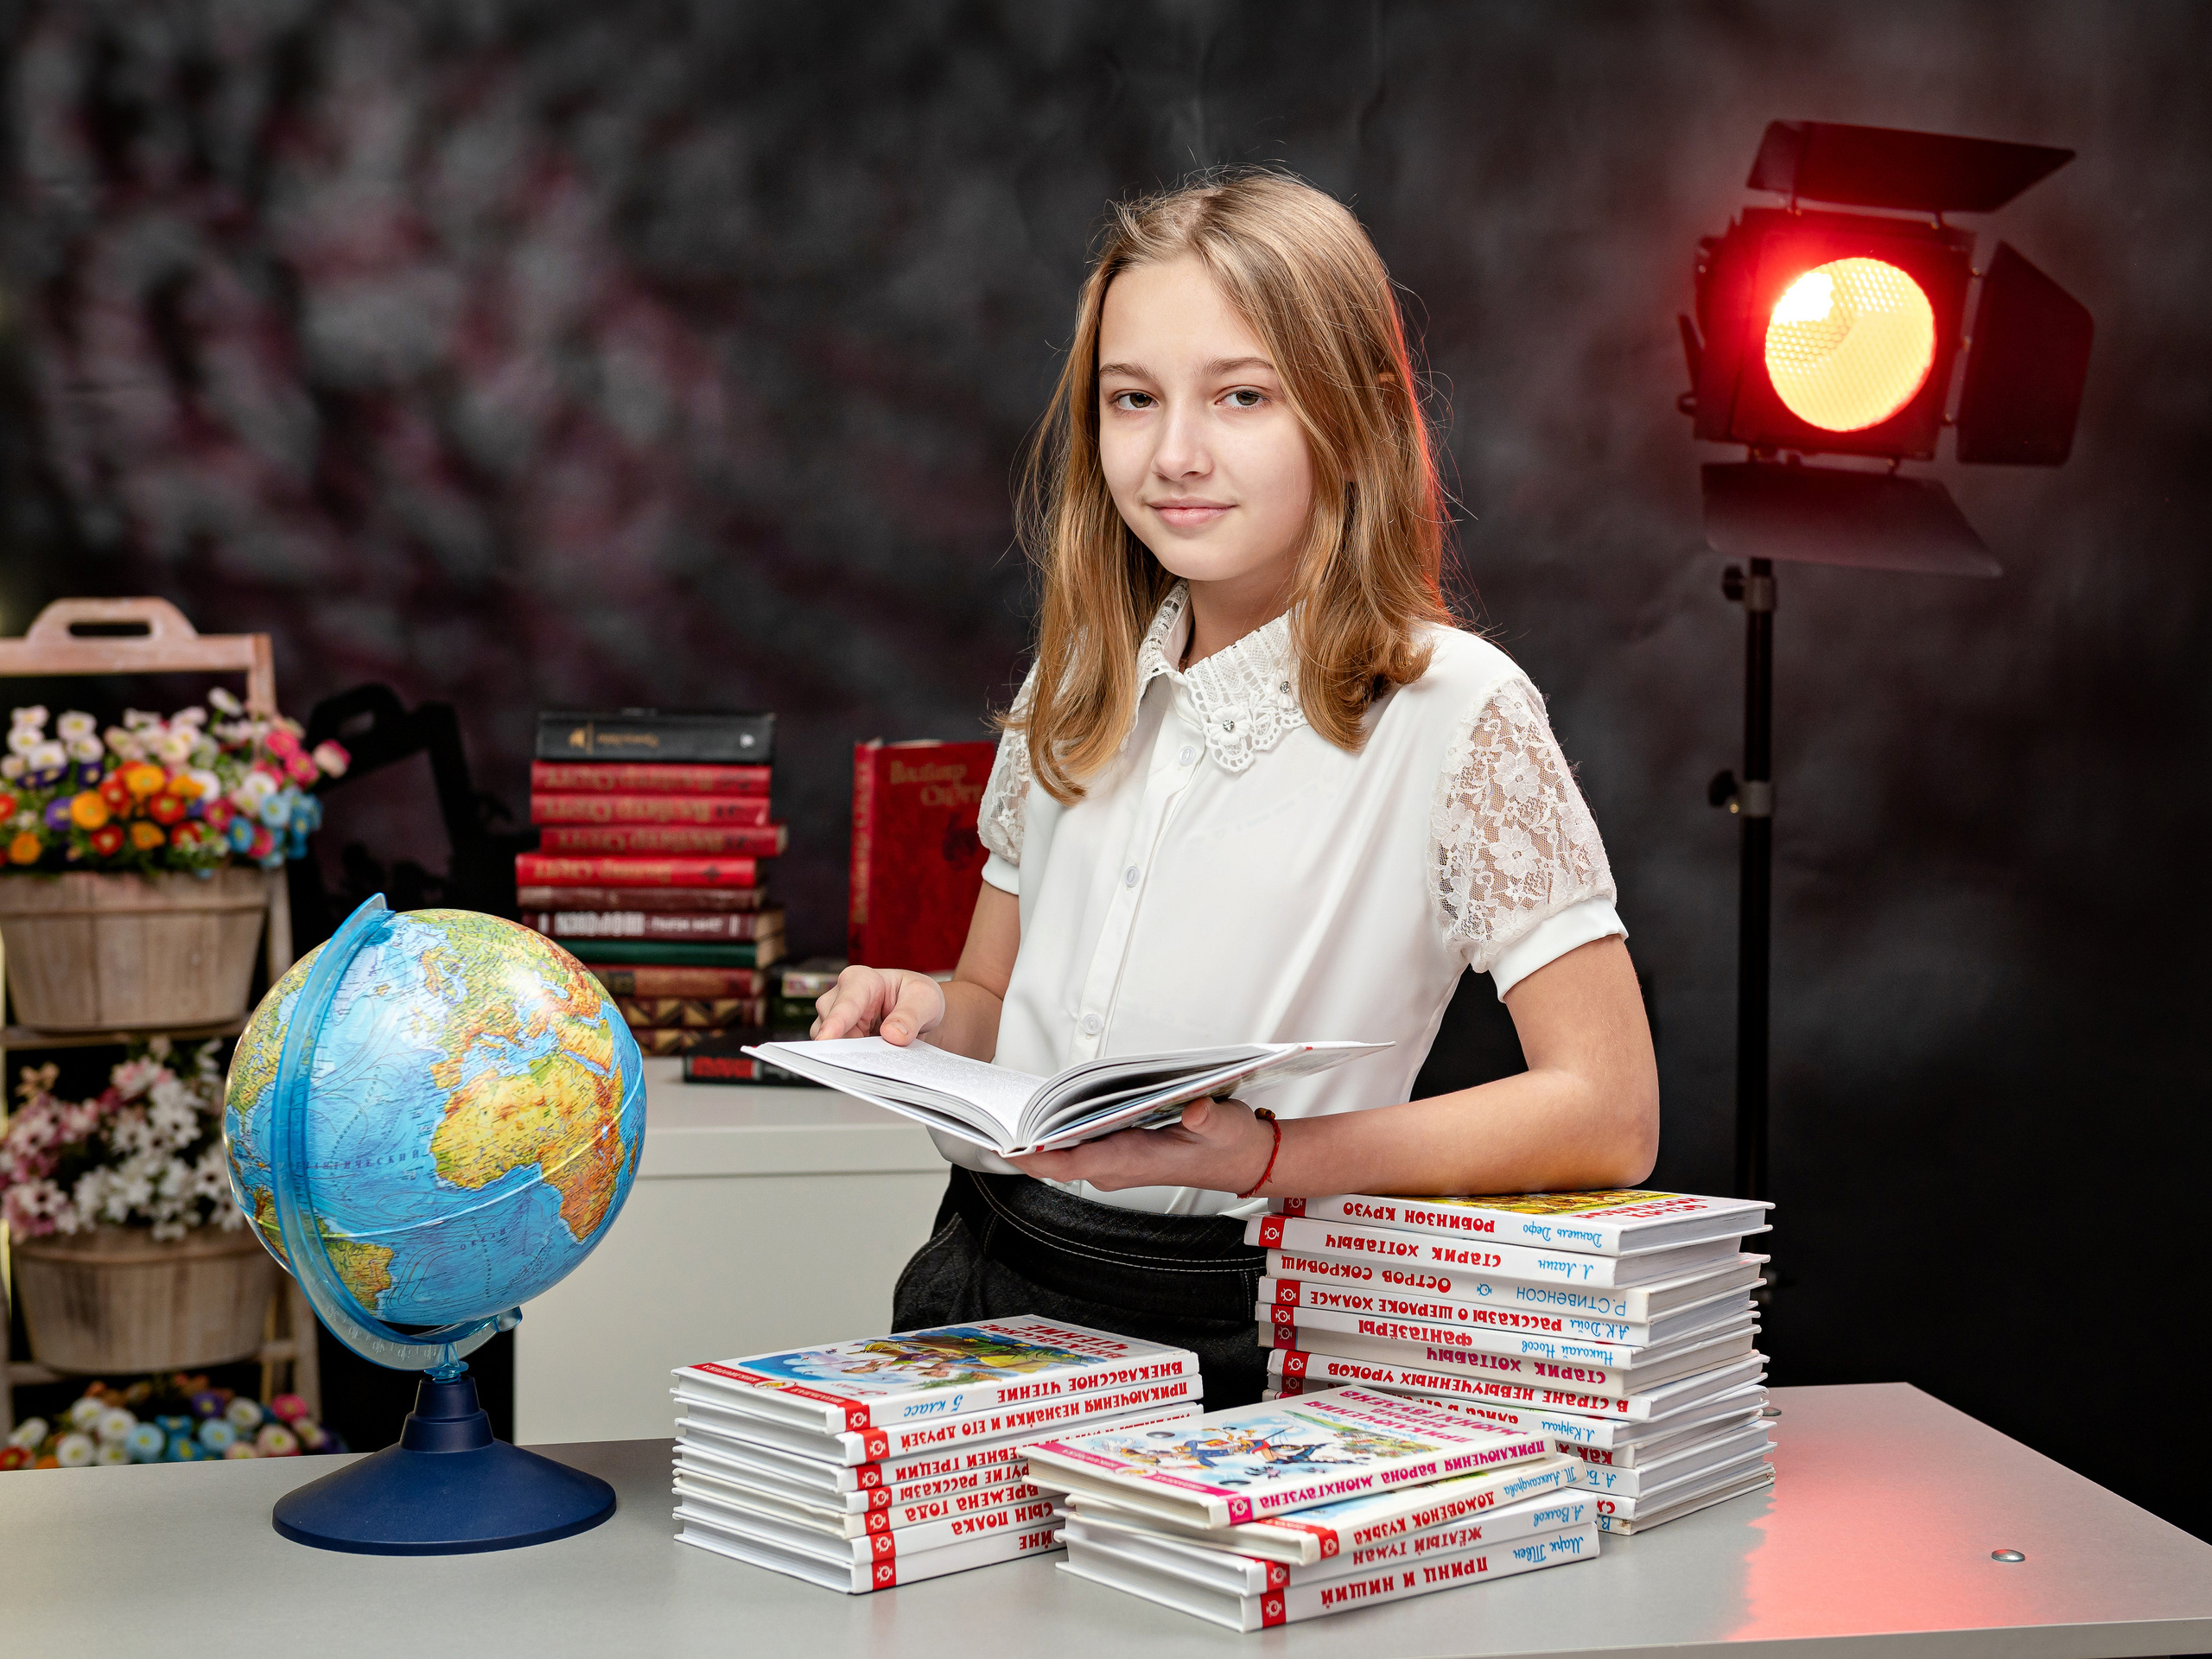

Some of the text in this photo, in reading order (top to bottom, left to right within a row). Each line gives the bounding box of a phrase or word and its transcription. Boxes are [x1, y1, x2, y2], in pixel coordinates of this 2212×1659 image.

[1343, 1202, 1602, 1248] Даниель Дефо РОБИНЗОН КРУЗО
[1325, 1234, 1419, 1257] ХОТТАБЫЧ
[1431, 1246, 1502, 1268] СТАРИК
[1281, 1255, 1372, 1281] СОКРОВИЩ
[1382, 1270, 1452, 1294] ОСТРОВ
[1310, 1291, 1374, 1310] ХОЛМСЕ
[1379, 1298, 1453, 1319] ШЕРЛОКЕ
[1458, 1308, 1468, 1320] О
[1472, 1310, 1562, 1332] РАССКАЗЫ
[1358, 1319, 1613, 1367] Николай Носов ФАНТАЗЁРЫ
[1327, 1363, 1394, 1382] УРОКОВ
[1426, 1347, 1605, 1384] СТАРИК ХОТТАБЫЧ
[903, 1361, 1182, 1418] ВНЕКЛАССНОЕ ЧТЕНИЕ 5 класс
[1085, 1382, 1187, 1413] ПРИКЛЮЧЕНИЯ
[1400, 1372, 1535, 1402] НЕВЫУЧЕННЫХ
[1541, 1389, 1609, 1410] СТРАНЕ
[1006, 1402, 1079, 1428] НЕЗНАЙКИ
[1339, 1390, 1529, 1436] МЮНХГАУЗЕНА
[1616, 1400, 1629, 1413] В
[961, 1420, 985, 1436] ЕГО
[990, 1417, 1001, 1431] И
[1303, 1402, 1474, 1443] ПРИКЛЮЧЕНИЯ
[900, 1426, 956, 1452] ДРУЗЕЙ
[895, 1457, 959, 1482] ГРЕЦИИ
[1259, 1440, 1545, 1510] ПРИКЛЮЧЕНИЯ БАРОНА МЮНХГАУЗЕНА
[900, 1473, 978, 1501] РАССКАЗЫ
[905, 1484, 1039, 1522] ВРЕМЕНА ГОДА
[1412, 1491, 1494, 1529] ДОМОВЁНОК
[951, 1502, 1052, 1535] СЫН ПОЛКА
[1353, 1517, 1405, 1546] КУЗЬКА
[1352, 1541, 1407, 1566] ТУМАН
[1414, 1526, 1482, 1555] ЖЁЛТЫЙ
[1320, 1535, 1583, 1607] Марк Твен ПРИНЦ И НИЩИЙ
